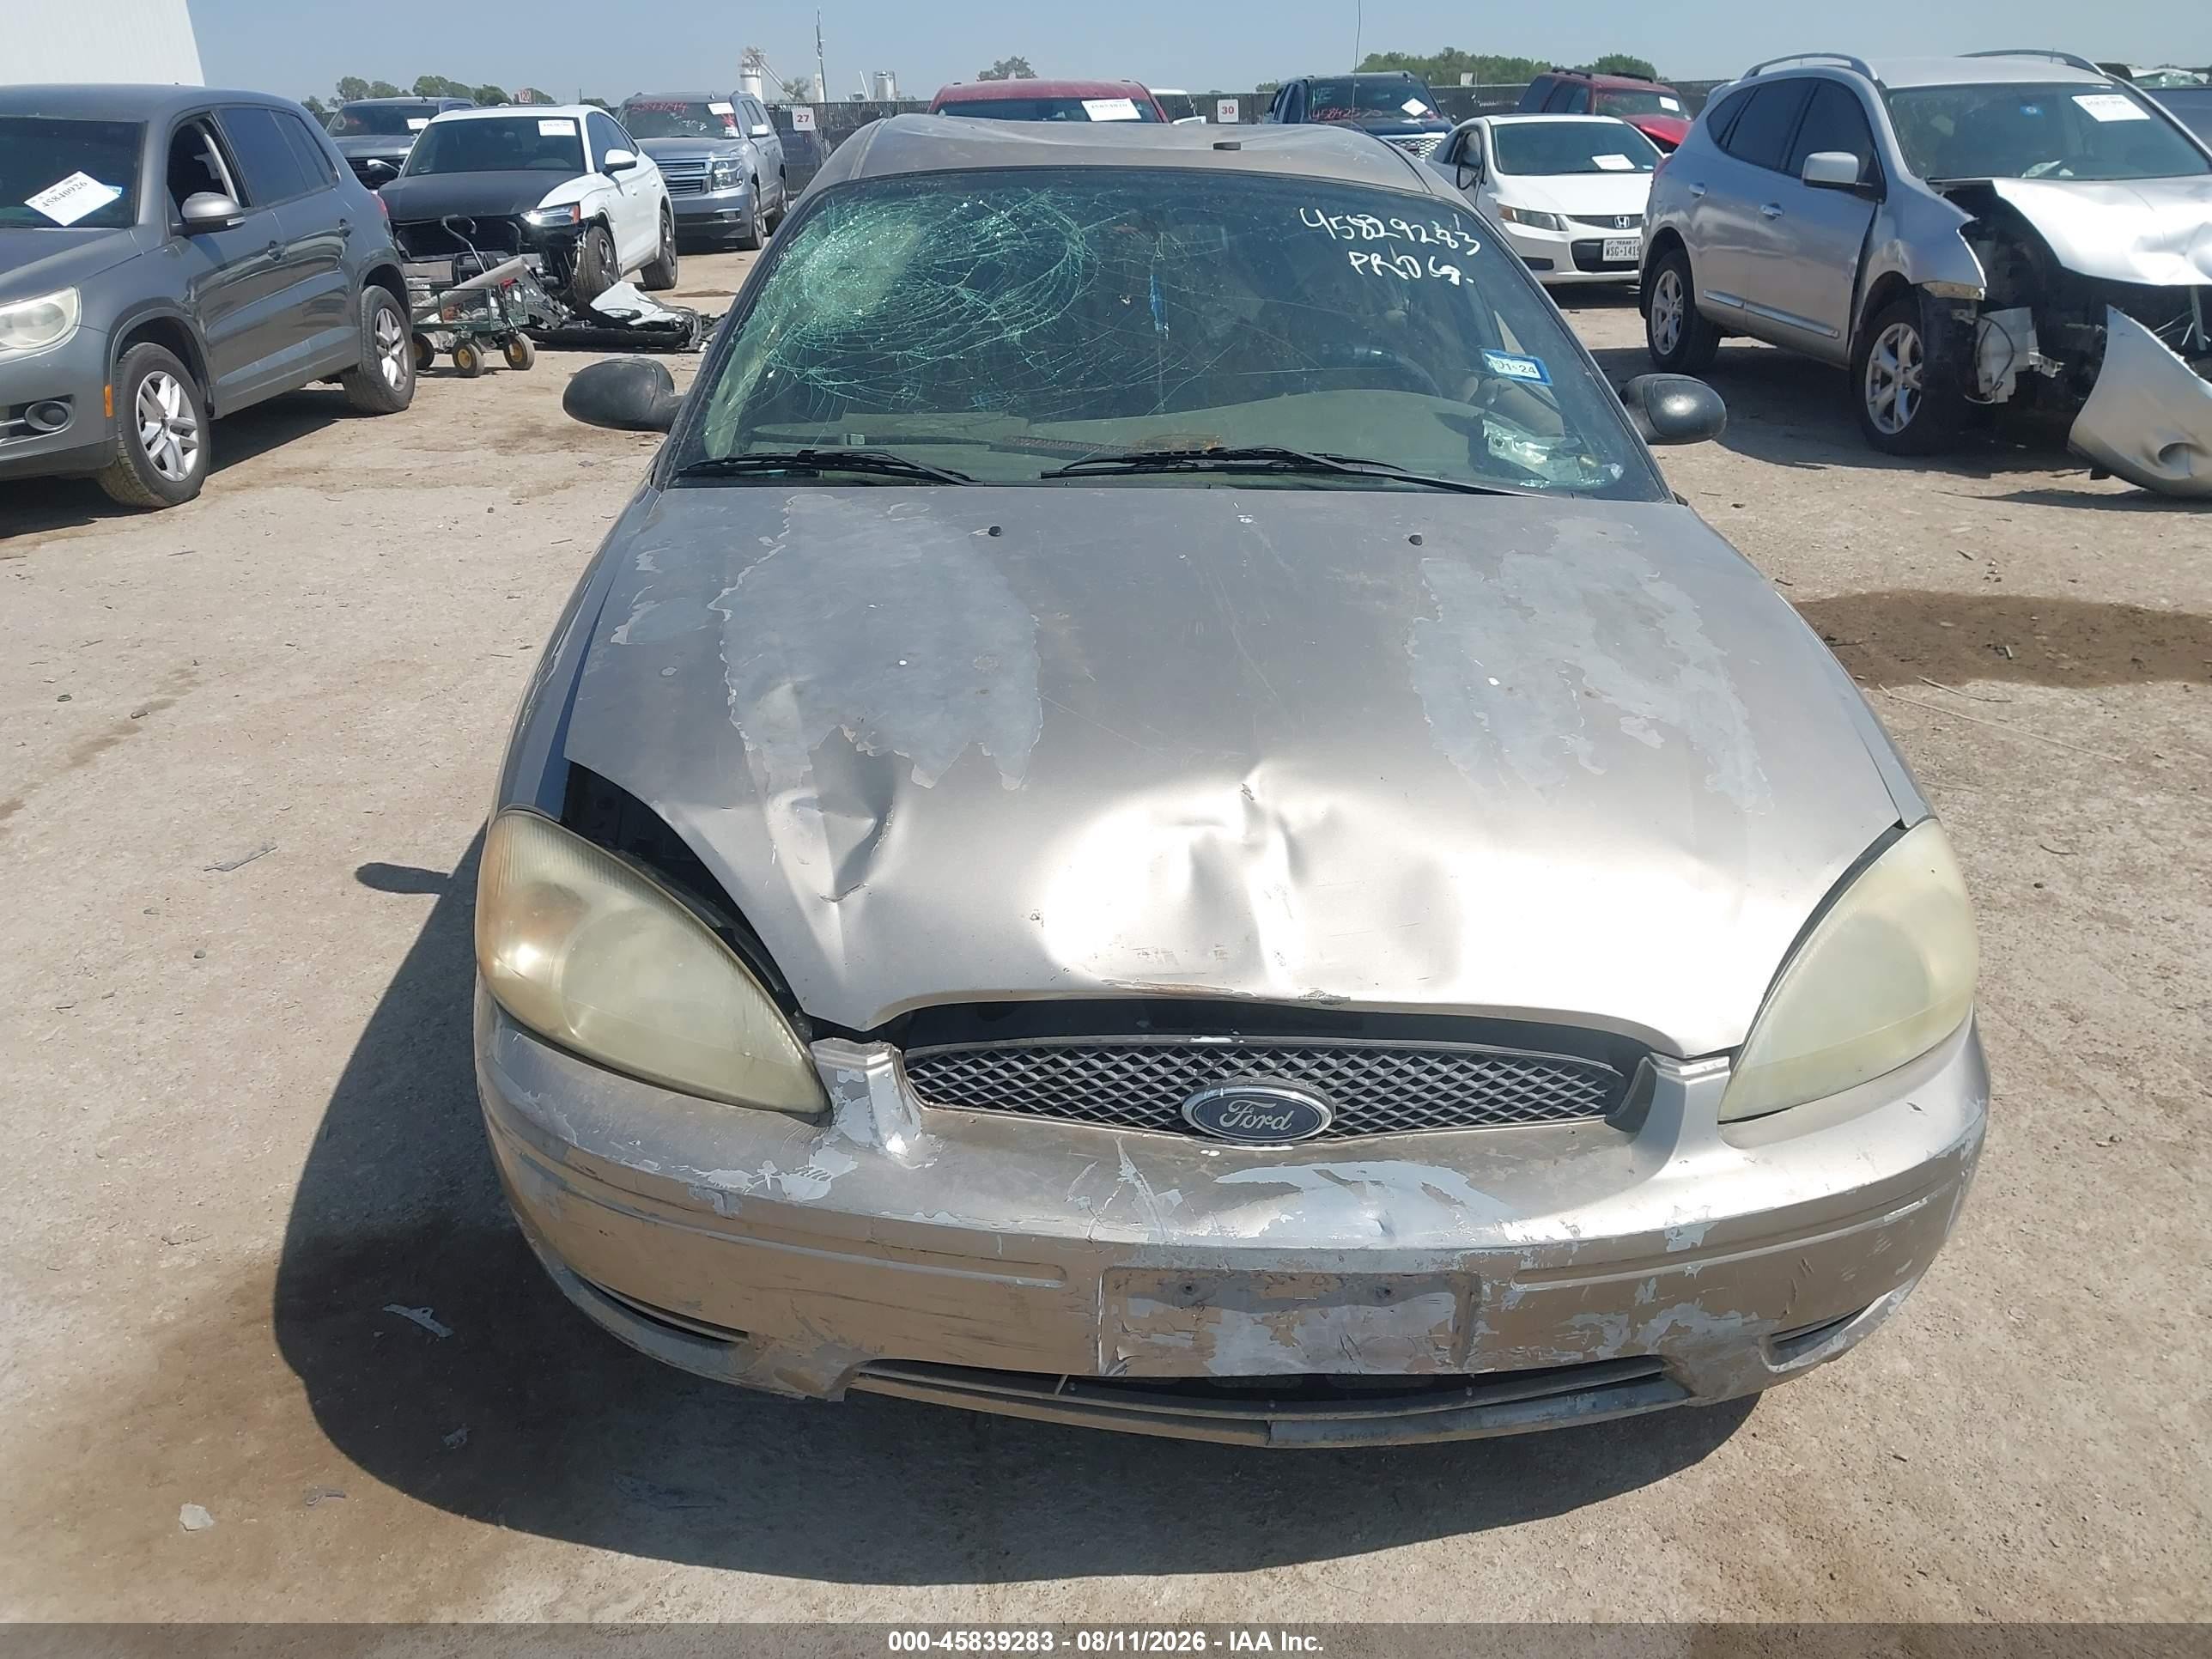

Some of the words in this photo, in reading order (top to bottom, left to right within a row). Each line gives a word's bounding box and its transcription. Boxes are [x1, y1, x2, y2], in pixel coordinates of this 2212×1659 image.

[1222, 106, 1235, 114] 30
[797, 114, 810, 123] 27
[1218, 1099, 1293, 1131] Ford
